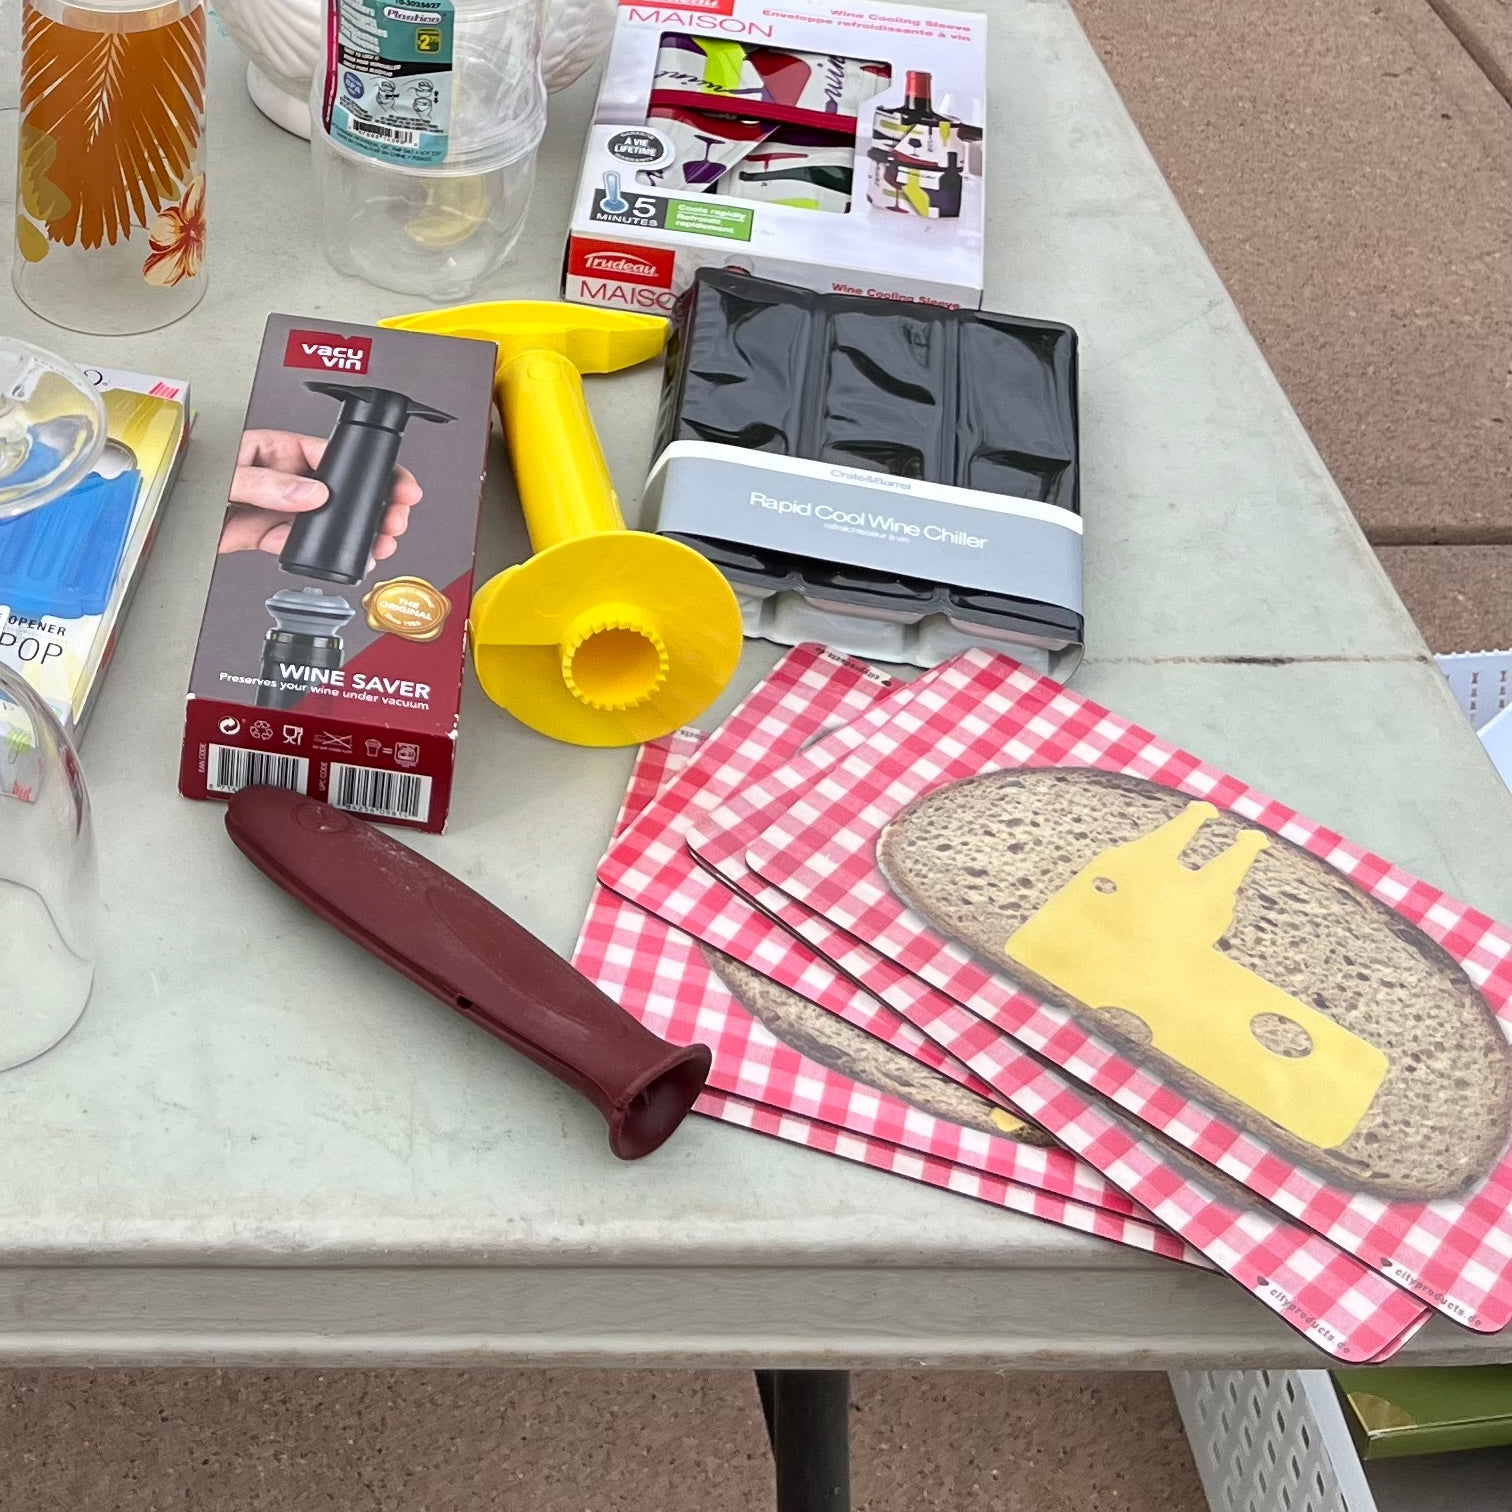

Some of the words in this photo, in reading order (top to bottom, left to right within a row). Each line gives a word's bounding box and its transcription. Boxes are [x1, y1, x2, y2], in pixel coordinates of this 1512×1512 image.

[628, 8, 773, 38] MAISON
[762, 9, 833, 25] Enveloppe
[950, 33, 971, 42] vin
[829, 8, 864, 19] Wine
[868, 13, 921, 27] Cooling
[925, 20, 971, 32] Sleeve
[614, 144, 657, 157] LIFETIME
[632, 197, 656, 218] 5
[677, 203, 709, 214] Cools
[710, 207, 747, 221] rapidly
[596, 212, 658, 227] MINUTES
[675, 220, 735, 234] rapidement
[584, 252, 658, 276] Trudeau
[580, 280, 679, 311] MAISO
[832, 282, 862, 295] Wine
[301, 343, 364, 360] vacu
[321, 356, 362, 371] vin
[830, 469, 912, 490] Crate&Barrel
[749, 491, 812, 516] Rapid
[814, 504, 866, 526] Cool
[868, 513, 921, 537] Wine
[923, 525, 989, 549] Chiller
[379, 599, 433, 621] ORIGINAL
[398, 597, 420, 609] THE
[8, 615, 67, 637] OPENER
[219, 671, 277, 688] Preserves
[279, 680, 307, 692] your
[310, 684, 339, 696] wine
[342, 687, 379, 703] under
[381, 695, 429, 711] vacuum
[279, 662, 346, 687] WINE
[351, 672, 432, 700] SAVER
[1395, 1266, 1482, 1328] cityproducts.de
[1269, 1287, 1350, 1355] cityproducts.de
